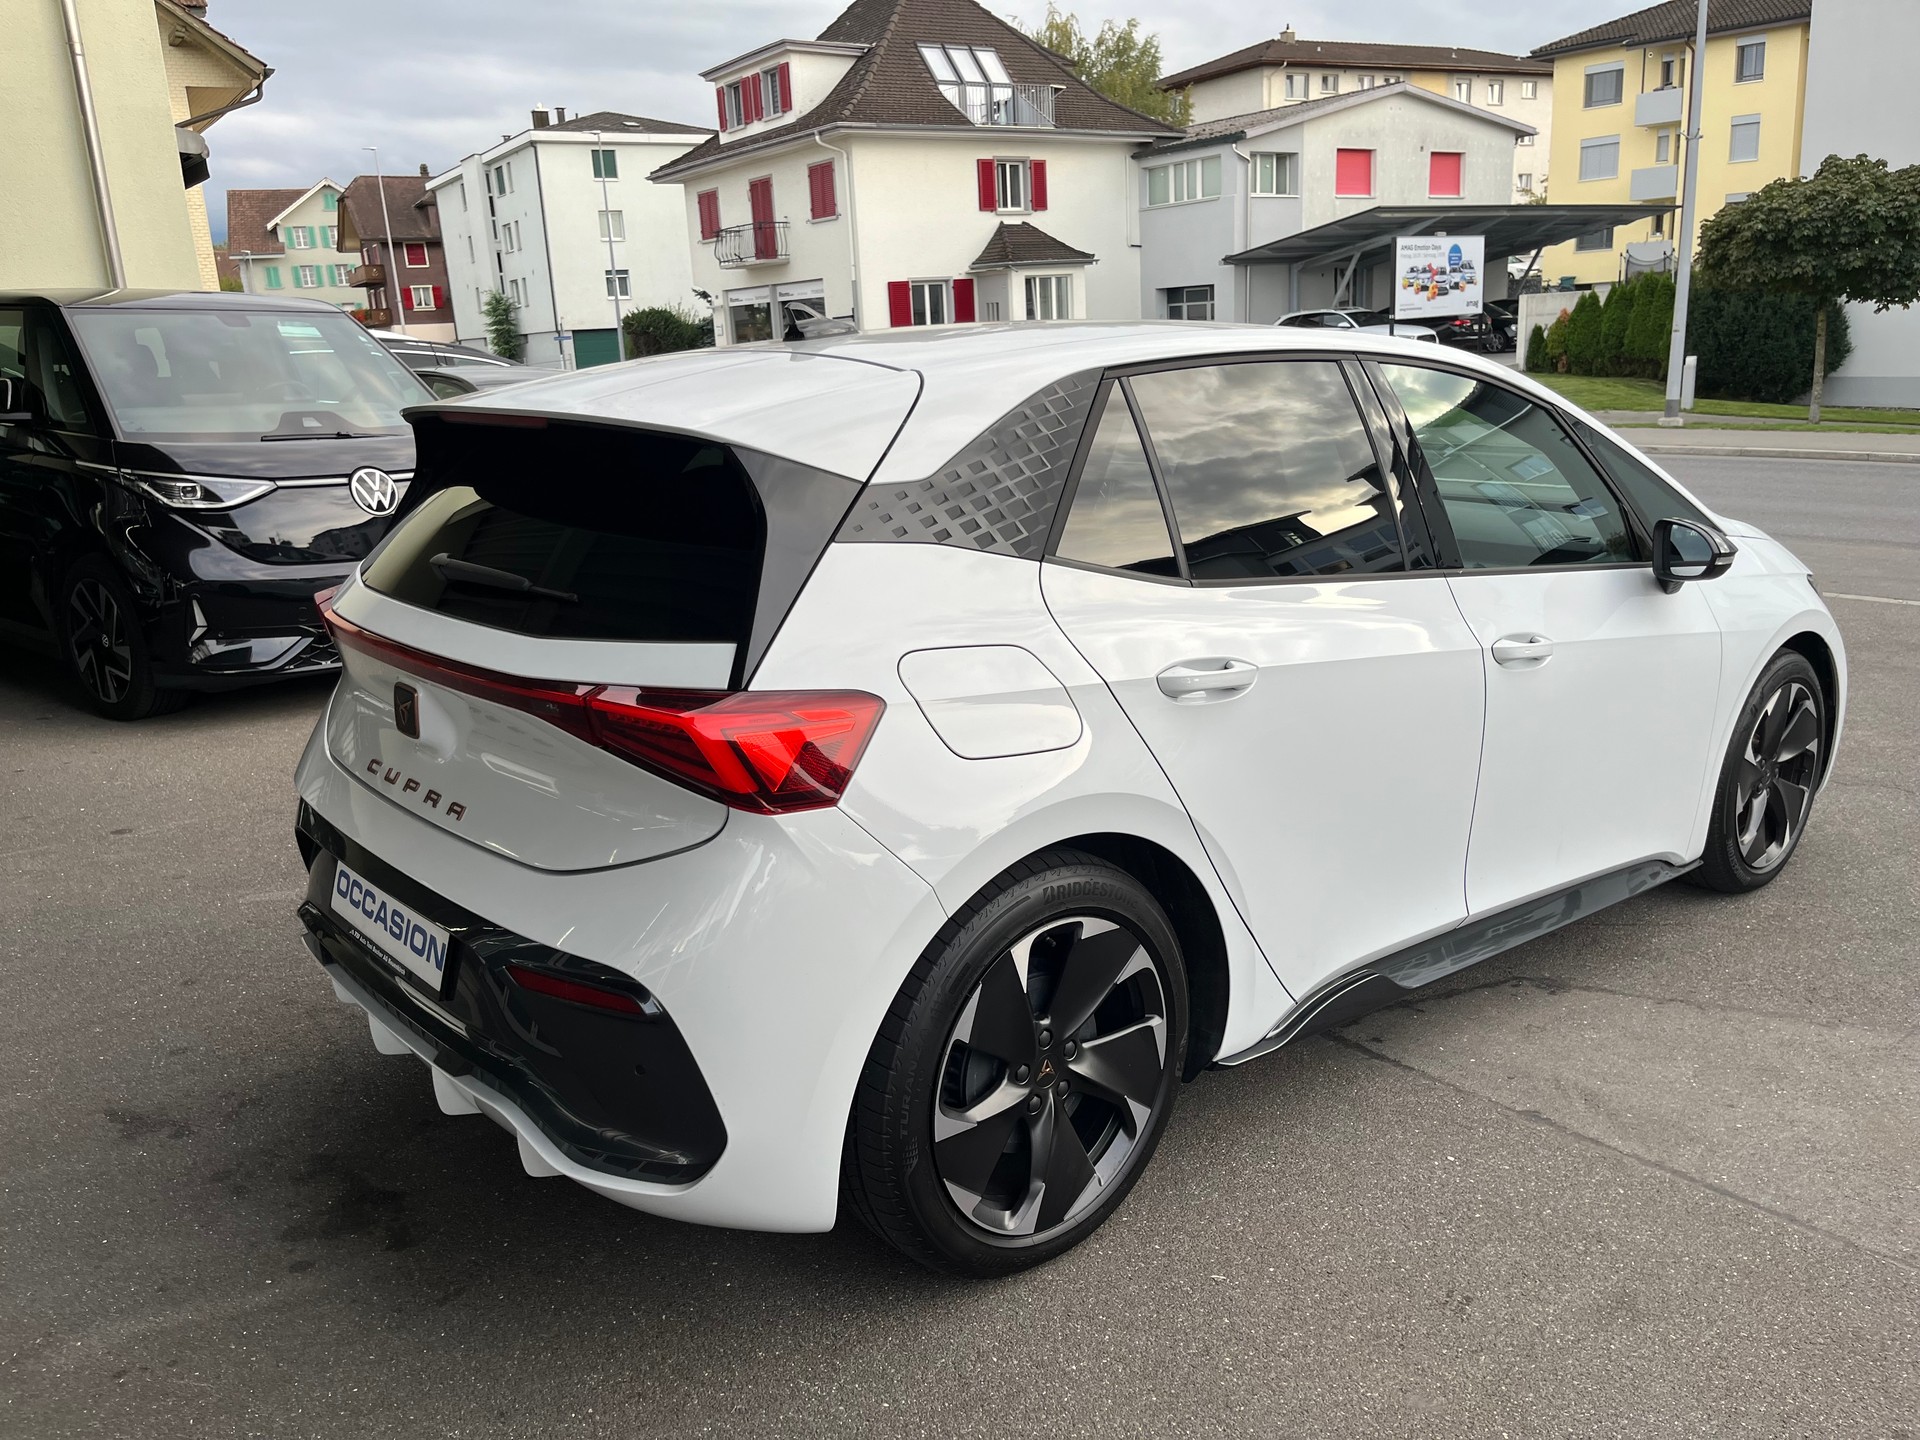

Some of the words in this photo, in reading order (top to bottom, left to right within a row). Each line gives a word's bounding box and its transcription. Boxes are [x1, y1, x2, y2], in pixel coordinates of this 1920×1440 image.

[366, 758, 467, 821] CUPRA
[336, 869, 447, 972] OCCASION
[1042, 880, 1139, 911] BRIDGESTONE
